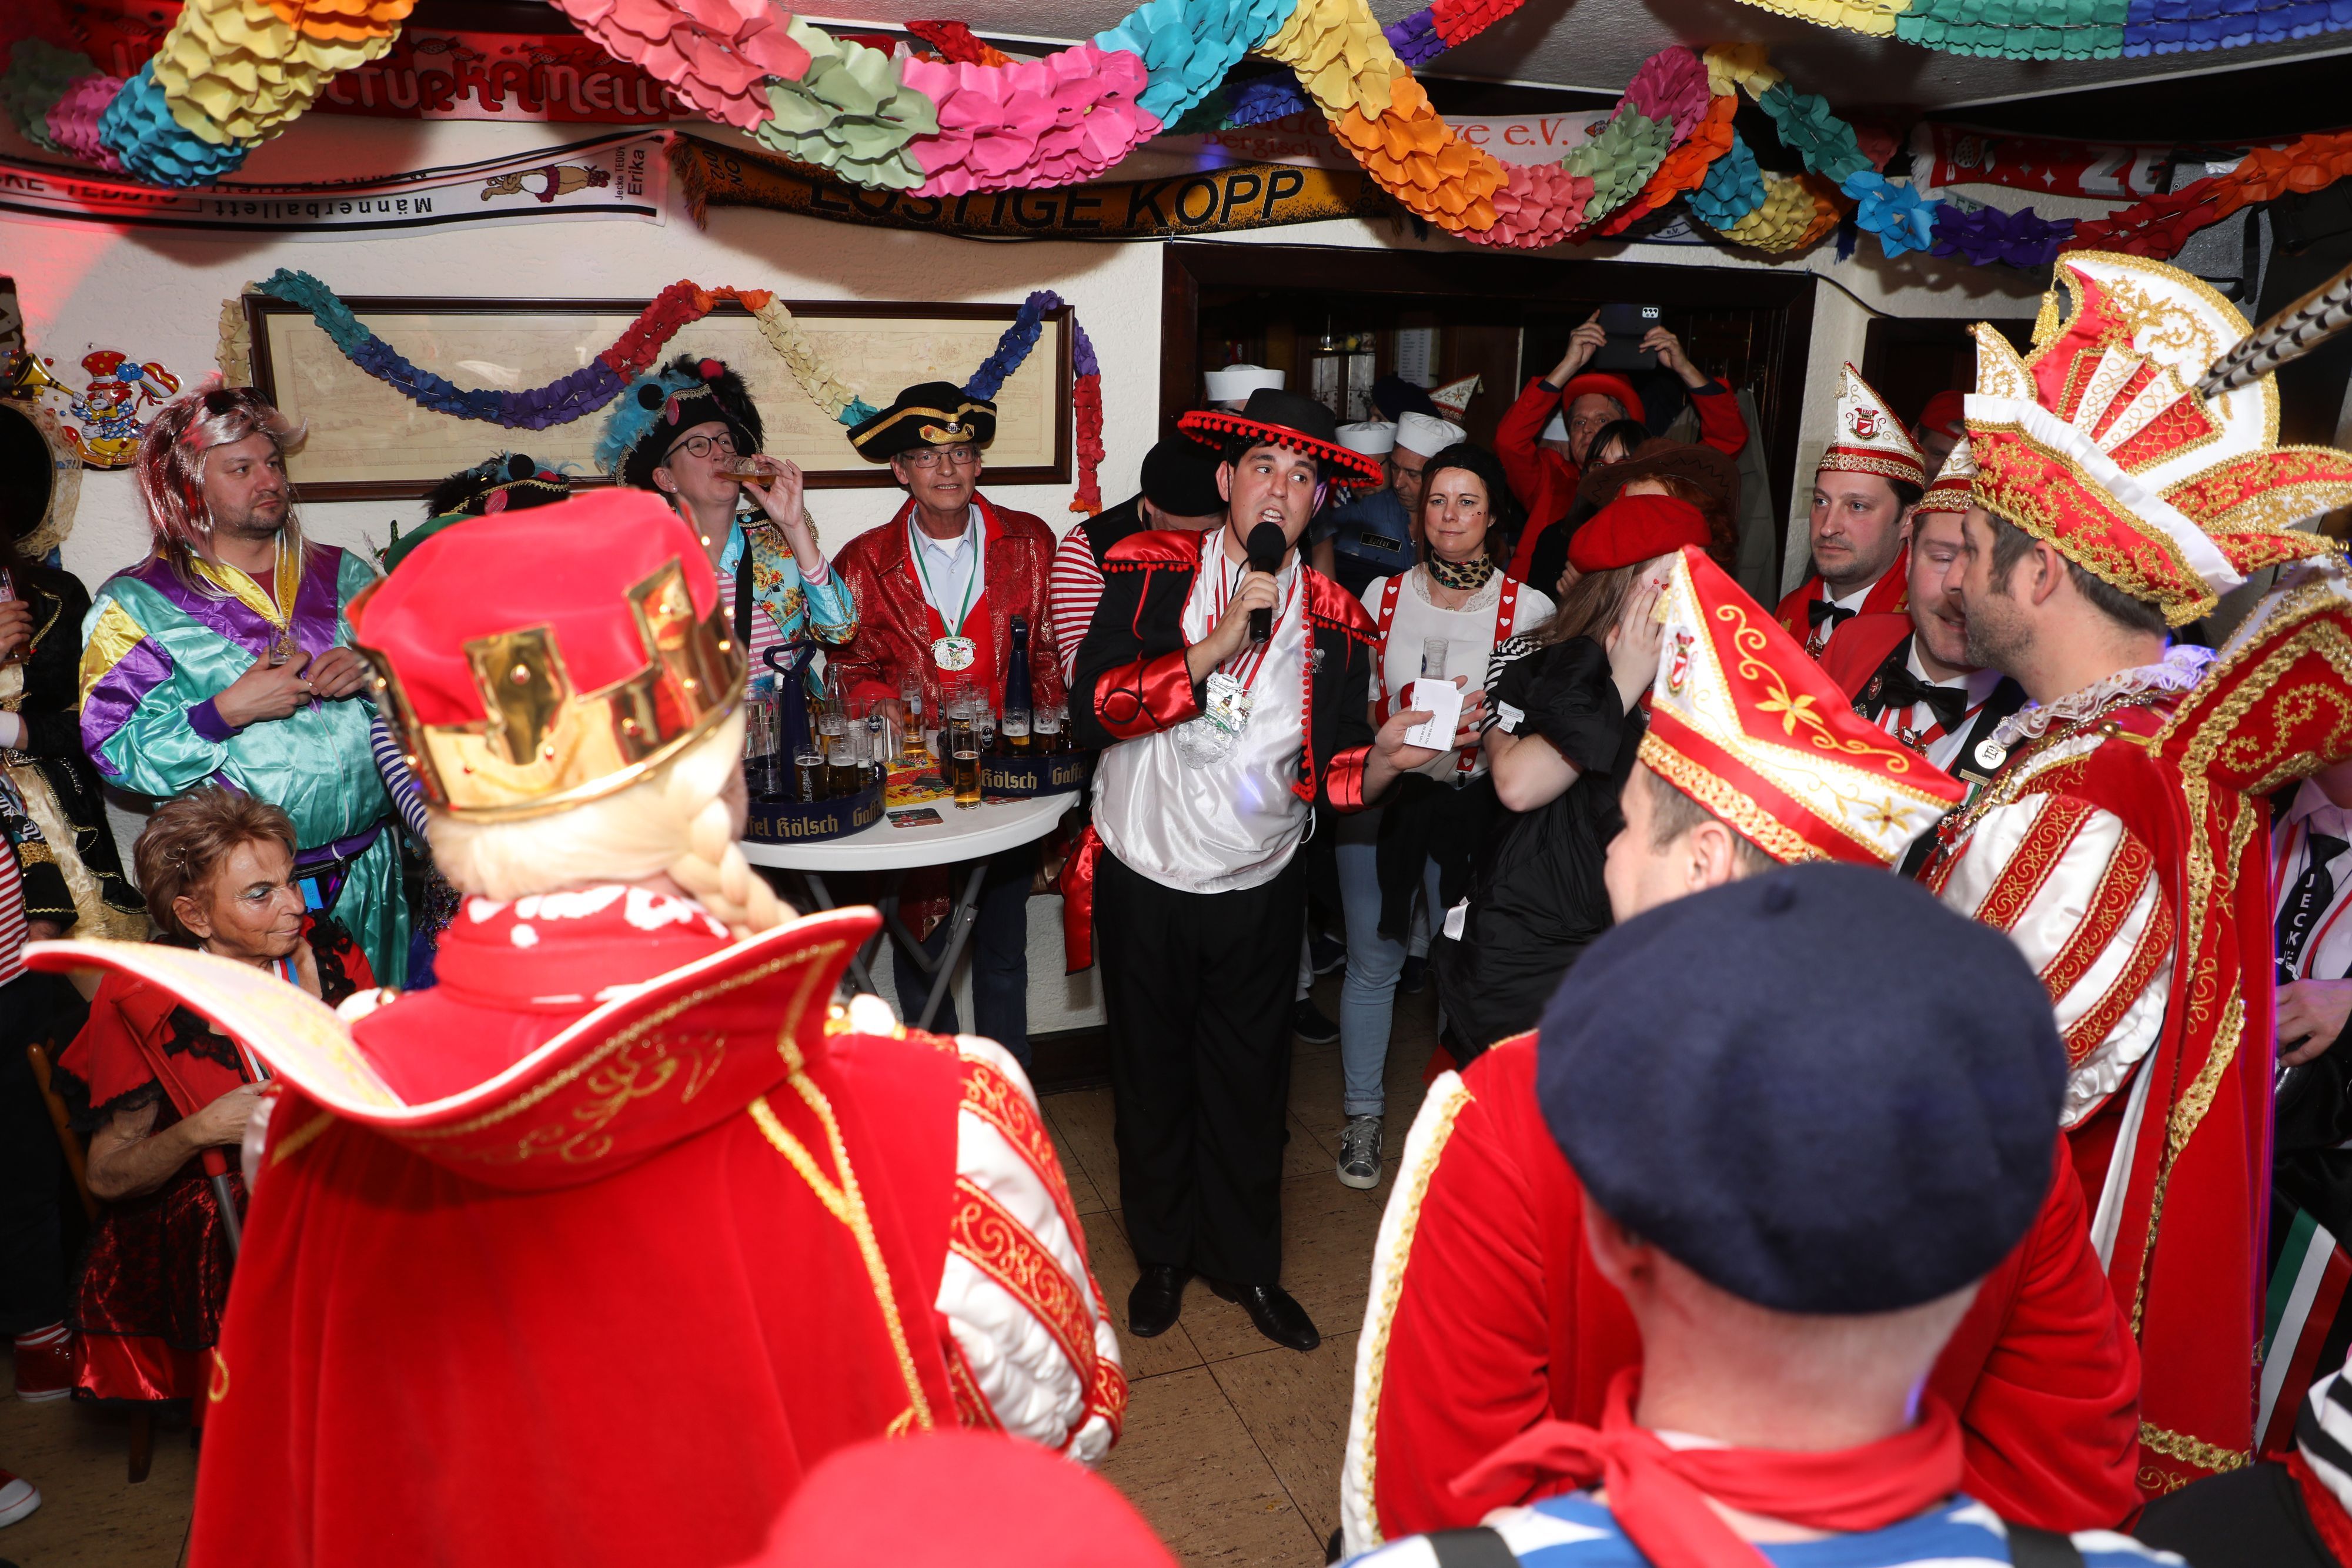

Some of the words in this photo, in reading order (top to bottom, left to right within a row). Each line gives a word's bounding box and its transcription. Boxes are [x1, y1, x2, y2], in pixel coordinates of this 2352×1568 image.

[1504, 119, 1568, 145] e.V.
[627, 149, 644, 196] Erika
[615, 176, 624, 200] Jecke
[1125, 169, 1304, 229] KOPP
[215, 198, 432, 219] Männerballett
[981, 768, 1037, 790] Kölsch
[776, 814, 838, 838] Kölsch
